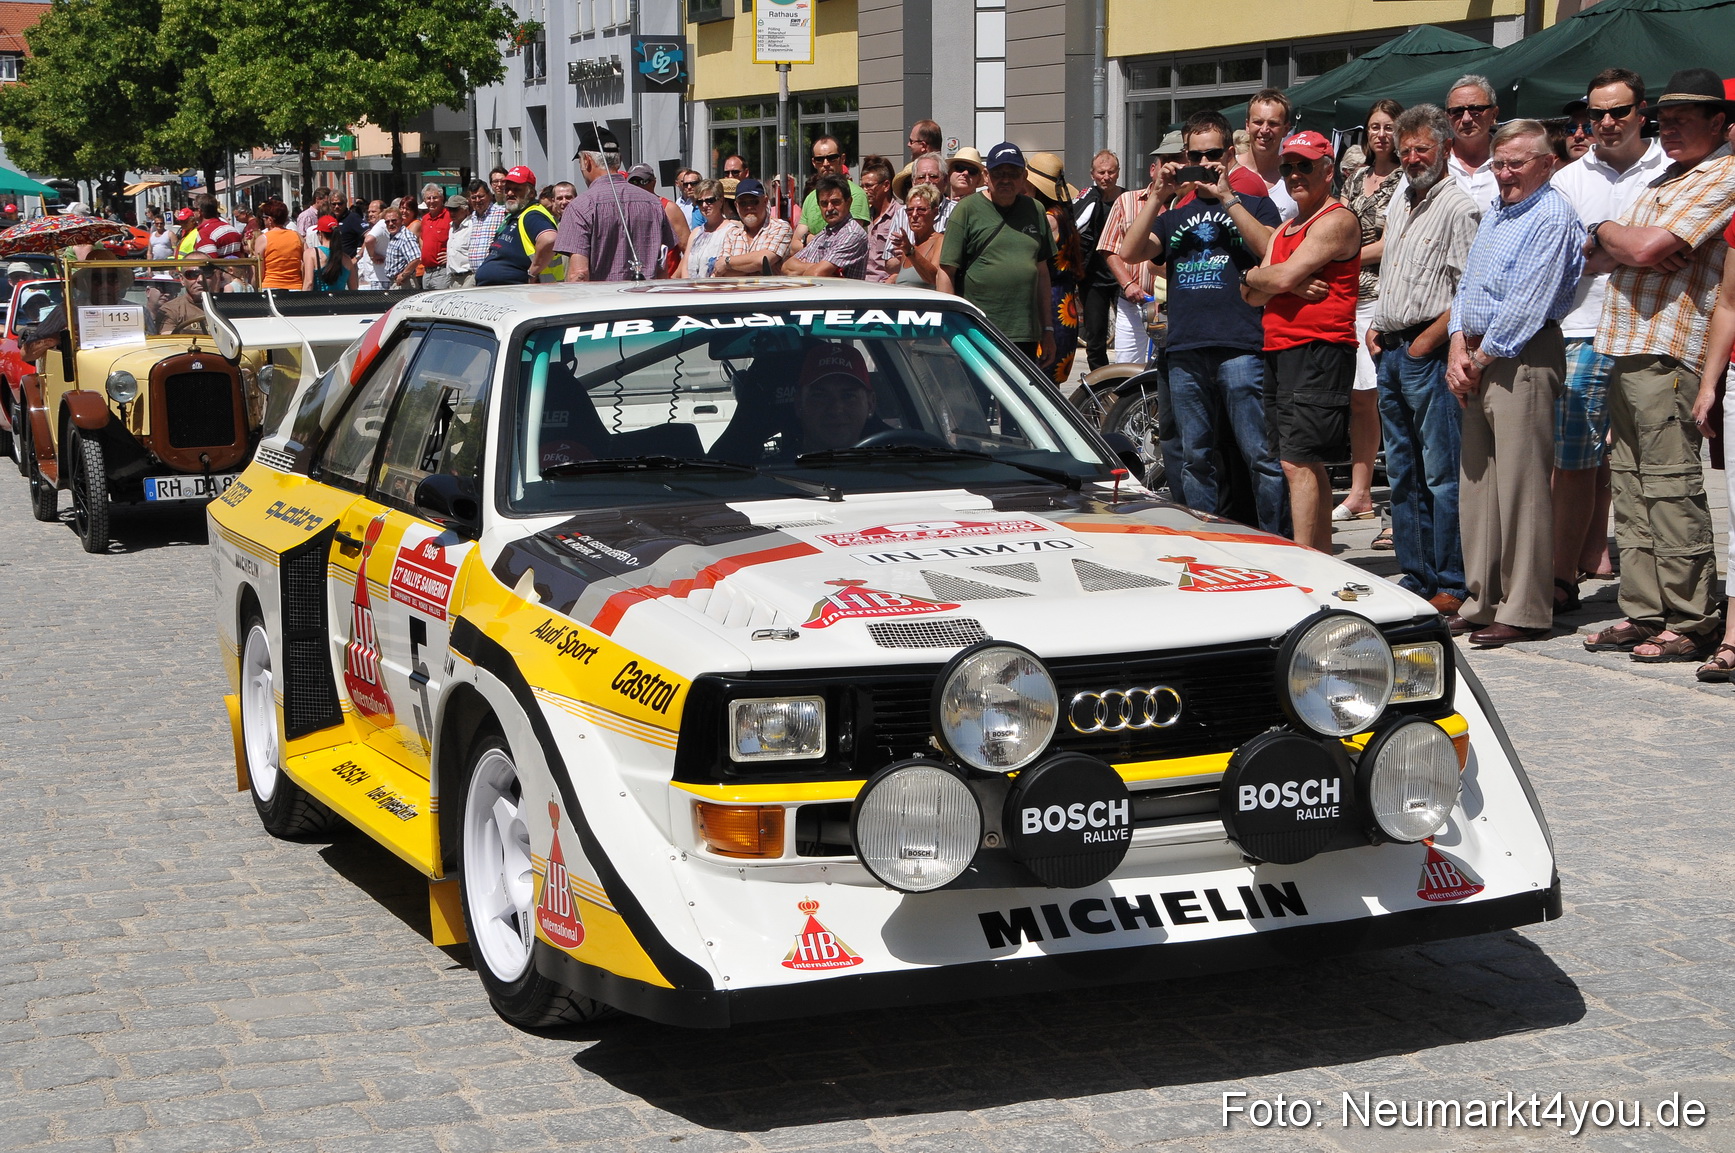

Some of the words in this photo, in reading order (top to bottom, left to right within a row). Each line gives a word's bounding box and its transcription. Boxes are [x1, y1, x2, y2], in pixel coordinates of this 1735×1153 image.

[652, 51, 670, 74] G2
[1176, 262, 1226, 272] SUNSET
[1208, 255, 1229, 264] 1973
[1178, 270, 1221, 283] CREEK
[108, 312, 130, 322] 113
[562, 318, 654, 344] HB
[789, 309, 942, 327] TEAM
[819, 357, 853, 369] DEKRA
[157, 480, 182, 497] RH
[265, 500, 324, 531] quattro
[837, 533, 915, 545] RALLYE
[925, 524, 1035, 535] SANREMO
[422, 544, 440, 560] 1985
[868, 543, 1016, 563] IN-NM
[1020, 539, 1074, 551] 70
[235, 554, 259, 578] MICHELIN
[1180, 567, 1269, 585] HB
[402, 569, 422, 589] RALLYE
[420, 576, 448, 599] SANREMO
[824, 592, 912, 611] HB
[821, 604, 942, 627] international
[350, 603, 378, 686] HB
[530, 618, 567, 644] Audi
[556, 630, 600, 665] Sport
[611, 660, 681, 715] Castrol
[350, 682, 390, 720] international
[331, 760, 371, 786] BOSCH
[1238, 777, 1340, 812] BOSCH
[1022, 798, 1129, 835] BOSCH
[1296, 806, 1340, 821] RALLYE
[1084, 828, 1129, 844] RALLYE
[1422, 862, 1462, 888] HB
[547, 859, 570, 918] HB
[1426, 888, 1478, 900] international
[978, 882, 1308, 949] MICHELIN
[542, 913, 578, 942] international
[795, 931, 839, 961] HB
[792, 958, 854, 970] international
